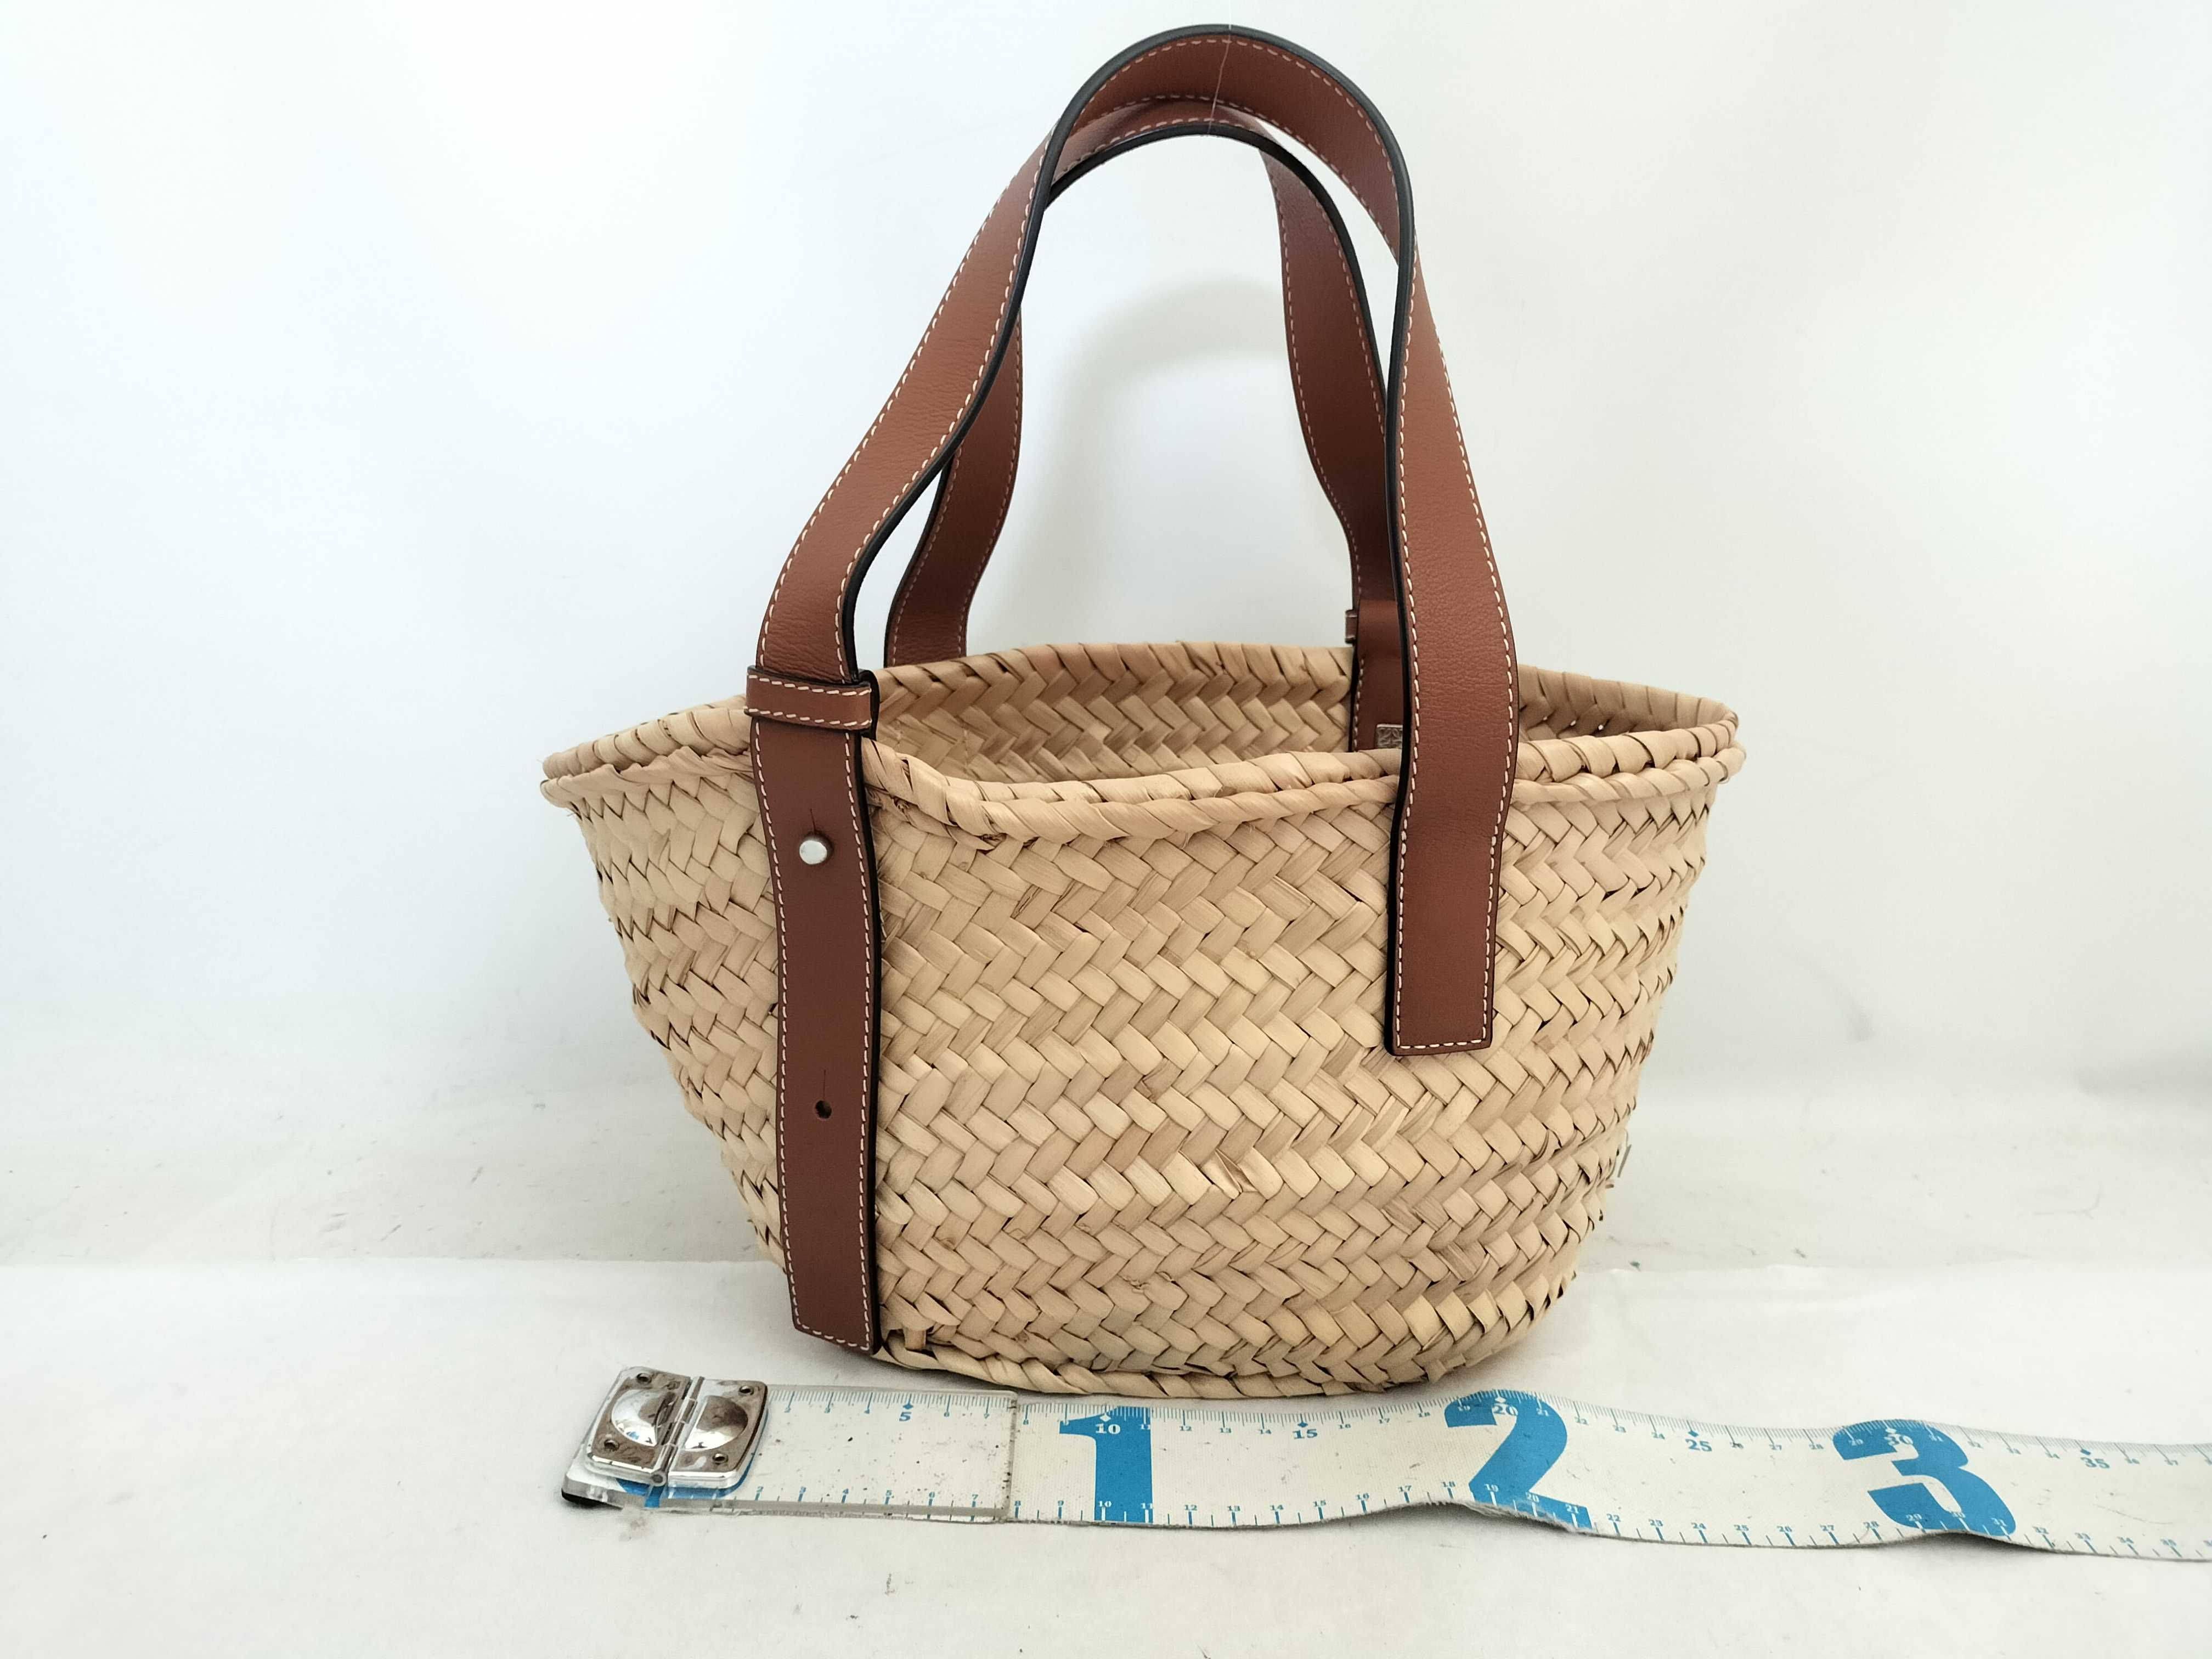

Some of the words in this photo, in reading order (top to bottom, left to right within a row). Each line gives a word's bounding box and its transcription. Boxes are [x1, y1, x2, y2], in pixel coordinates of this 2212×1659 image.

[899, 1412, 911, 1422] 5
[1095, 1424, 1121, 1435] 10
[1293, 1429, 1318, 1440] 15
[1492, 1404, 1519, 1416] 20
[1685, 1438, 1712, 1452] 25
[1885, 1435, 1914, 1446] 30
[2080, 1456, 2110, 1469] 35
[1059, 1406, 1153, 1522] 1
[1444, 1390, 1593, 1530] 2
[1832, 1419, 2016, 1536] 3
[1355, 1492, 1370, 1500] 16
[1484, 1483, 1499, 1492] 19
[1526, 1493, 1539, 1503] 20
[1565, 1504, 1579, 1514] 21
[1607, 1514, 1621, 1522] 22
[1649, 1519, 1663, 1527] 23
[1734, 1524, 1750, 1532] 25
[1906, 1514, 1922, 1522] 29
